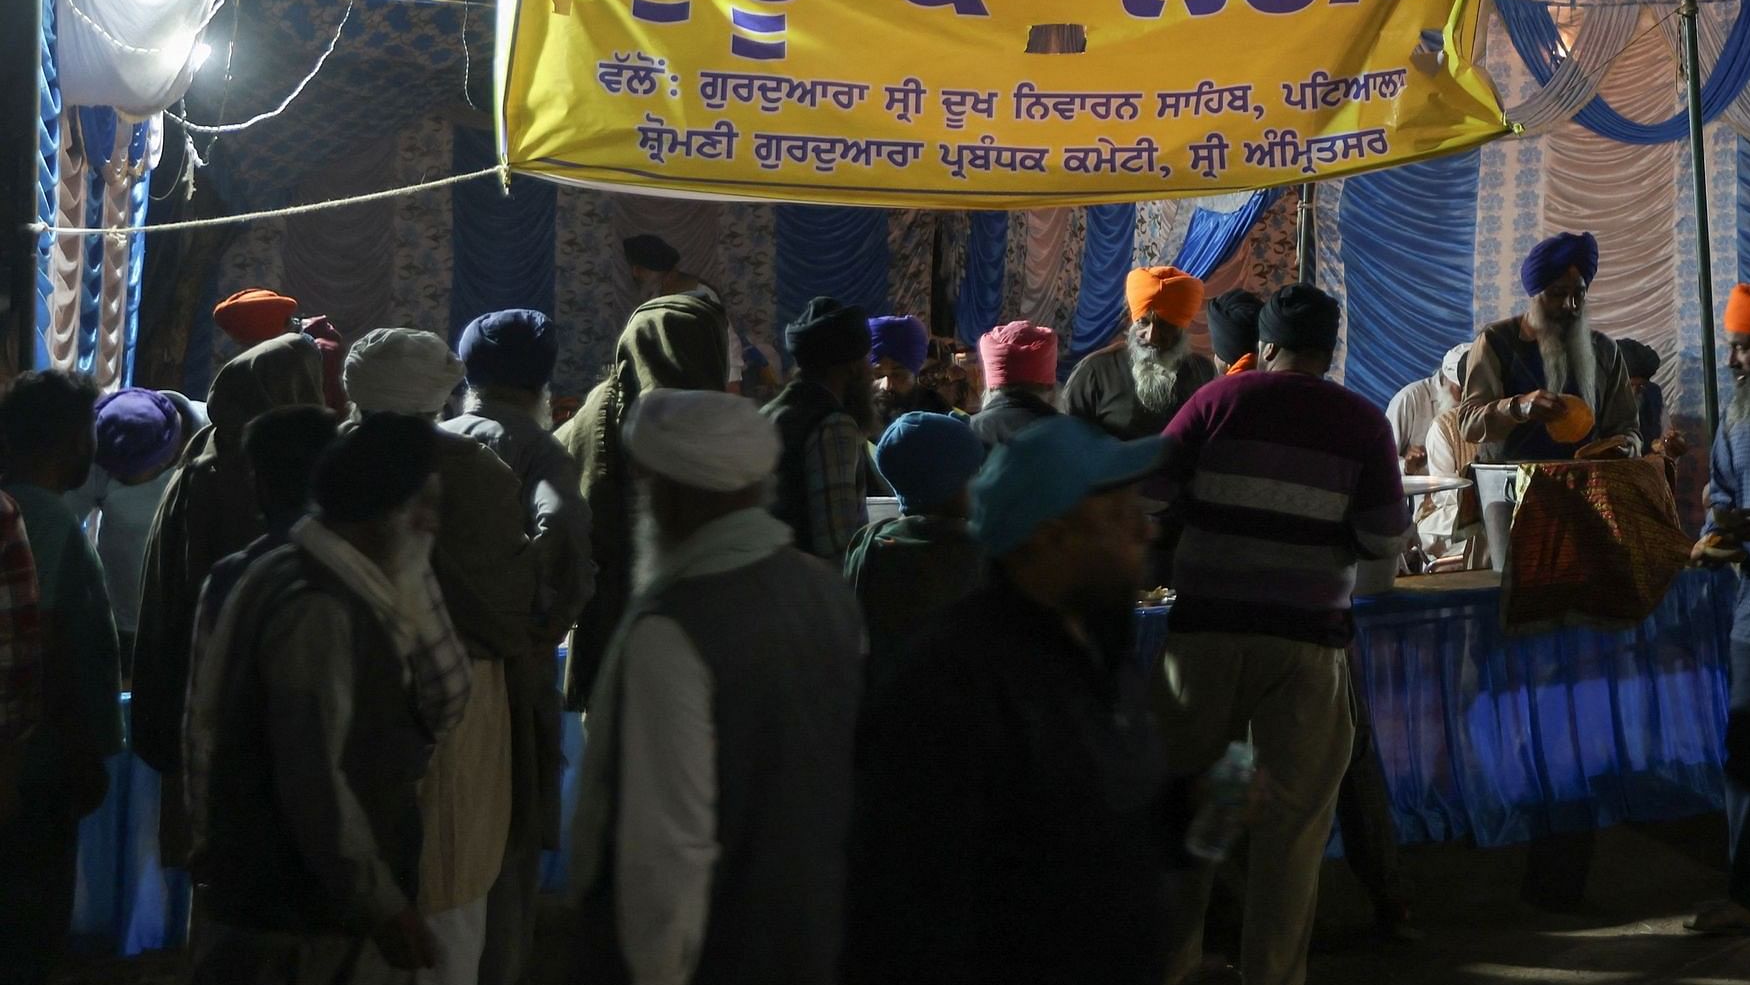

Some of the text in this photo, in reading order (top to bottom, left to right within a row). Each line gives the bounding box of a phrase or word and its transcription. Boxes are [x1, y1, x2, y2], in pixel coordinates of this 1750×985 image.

[599, 52, 1407, 129] ਵੱਲੋਂ: ਗੁਰਦੁਆਰਾ ਸ੍ਰੀ ਦੂਖ ਨਿਵਾਰਨ ਸਾਹਿਬ, ਪਟਿਆਲਾ
[638, 113, 1390, 179] ਸ਼੍ਰੋਮਣੀ ਗੁਰਦੁਆਰਾ ਪ੍ਰਬੰਧਕ ਕਮੇਟੀ, ਸ੍ਰੀ ਅੰਮ੍ਰਿਤਸਰ
